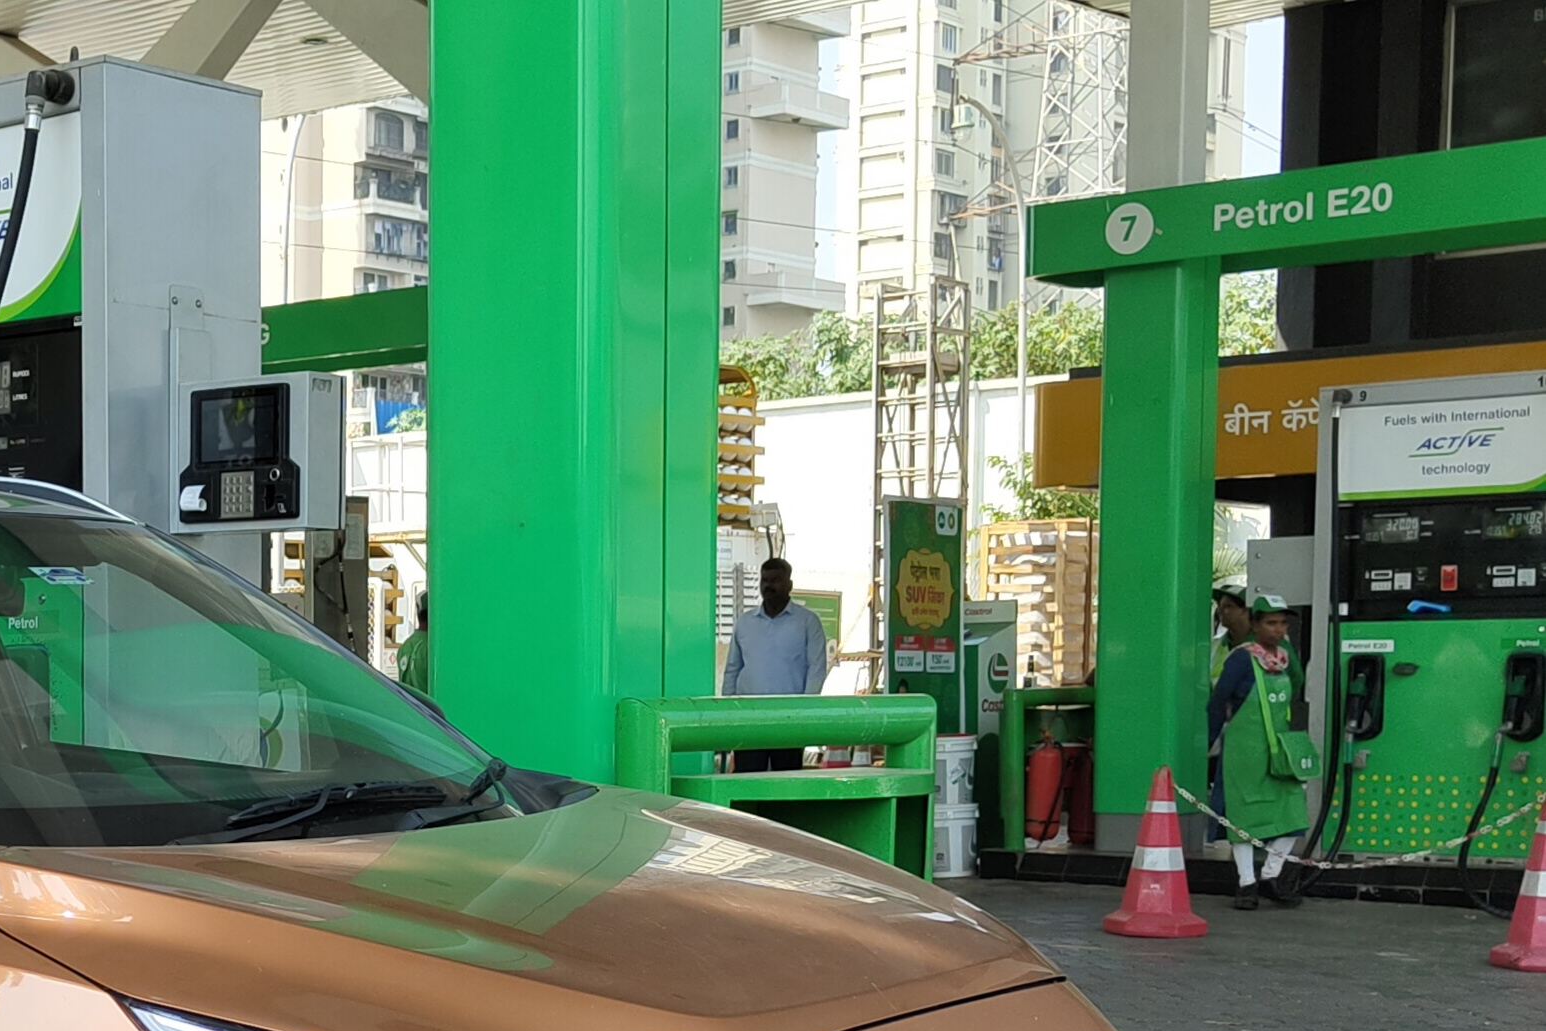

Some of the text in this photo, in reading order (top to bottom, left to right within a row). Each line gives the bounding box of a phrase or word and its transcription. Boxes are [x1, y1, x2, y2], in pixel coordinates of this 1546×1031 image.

[1120, 183, 1394, 242] 7 Petrol E20
[1359, 390, 1367, 402] 9
[1223, 403, 1272, 436] बीन
[1384, 406, 1531, 427] Fuels with International
[1416, 433, 1496, 451] ACTIVE
[1422, 461, 1491, 476] technology
[906, 585, 926, 604] SUV
[8, 617, 39, 630] Petrol
